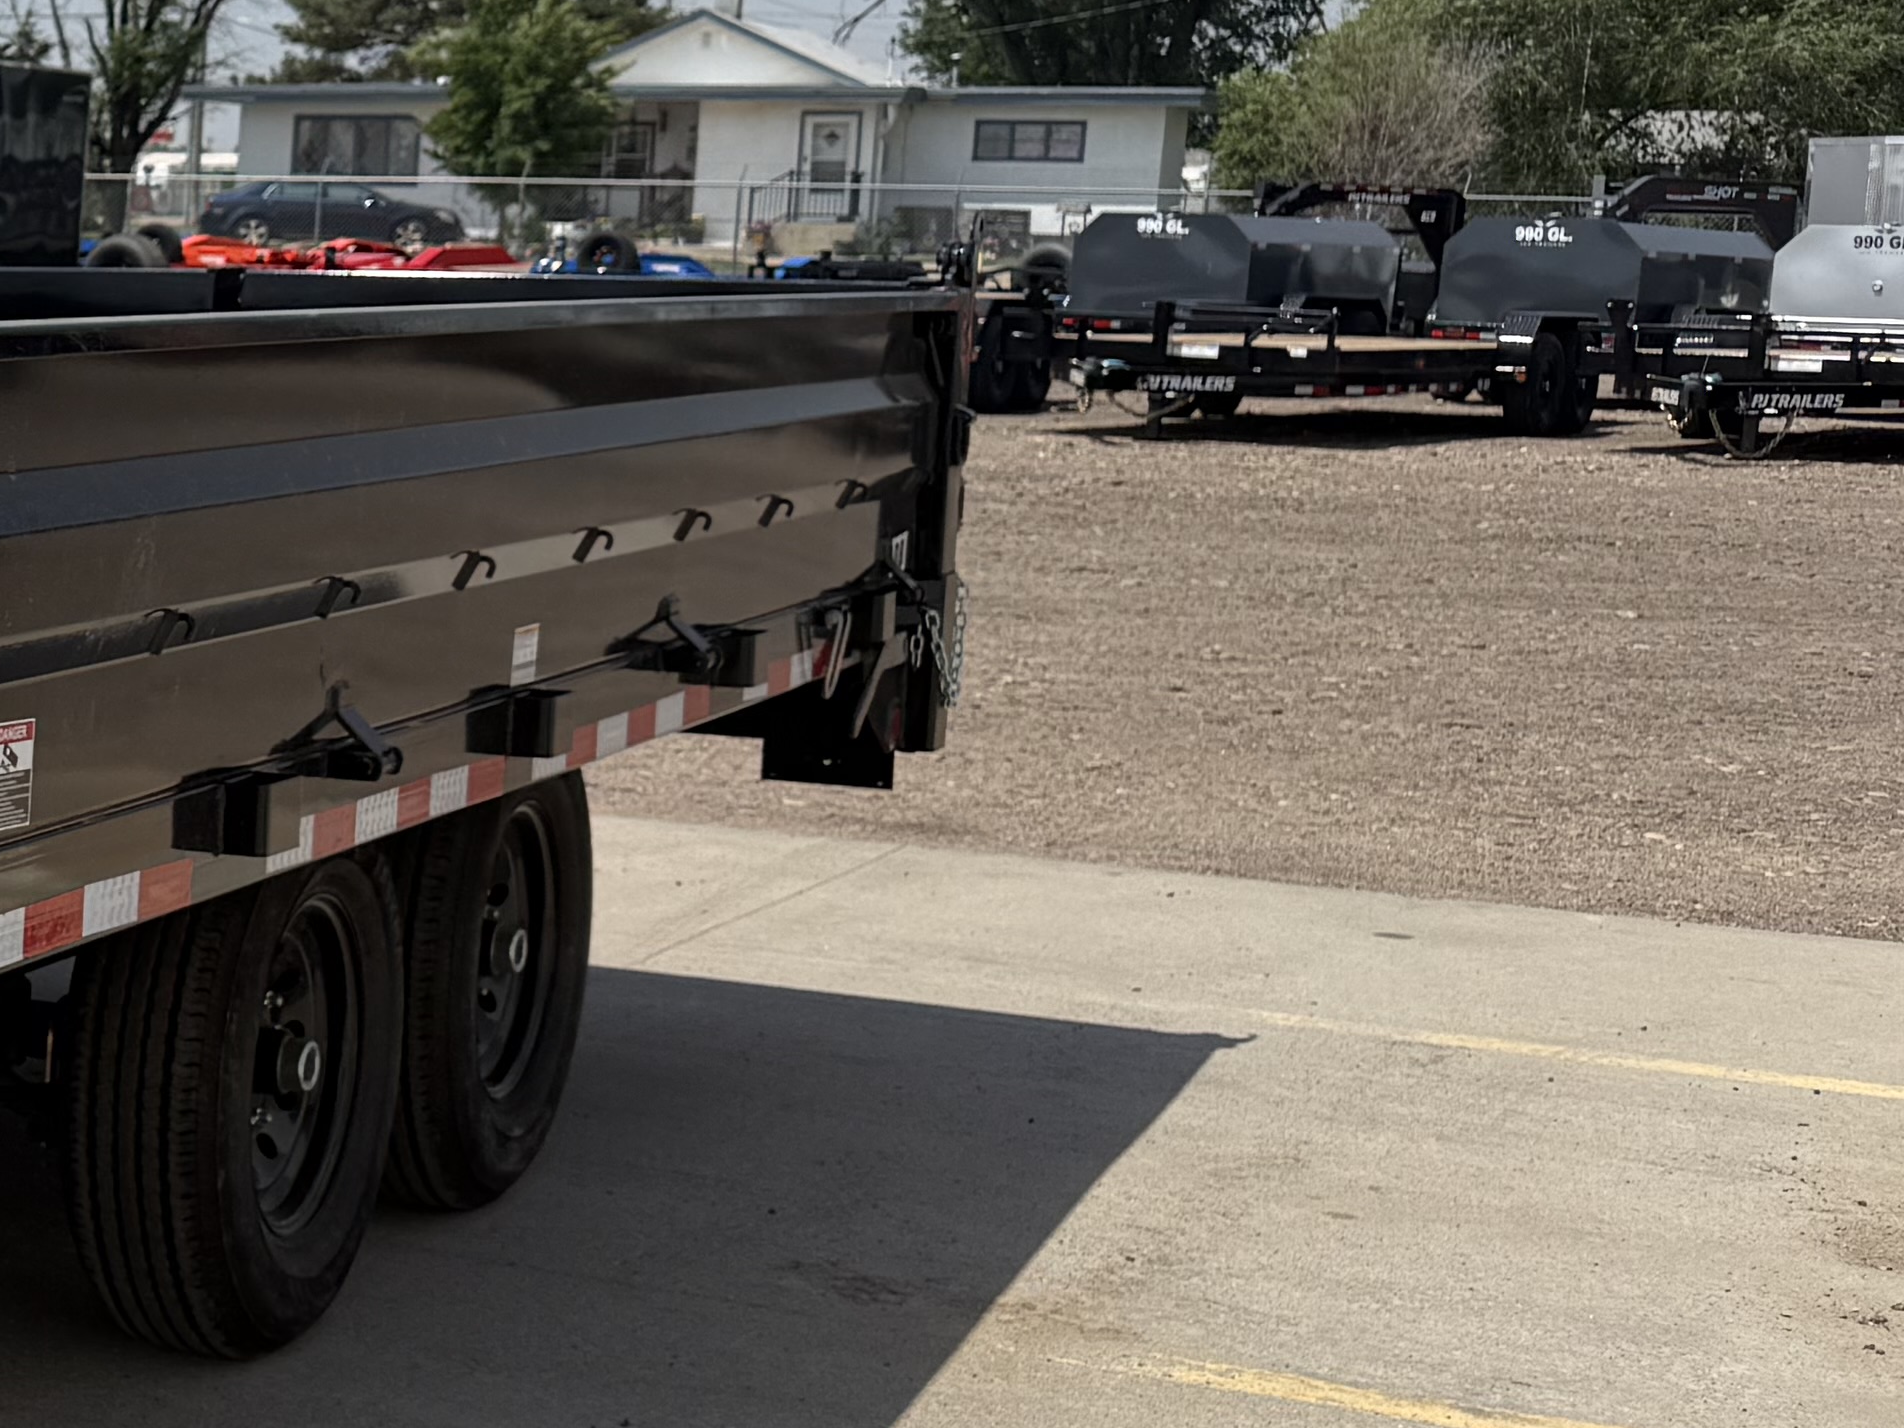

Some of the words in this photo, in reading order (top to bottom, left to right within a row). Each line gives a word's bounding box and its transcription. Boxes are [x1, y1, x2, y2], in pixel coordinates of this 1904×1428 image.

[1515, 226, 1543, 241] 990
[1854, 235, 1884, 249] 990
[1889, 235, 1904, 249] G
[1771, 393, 1845, 409] TRAILERS
